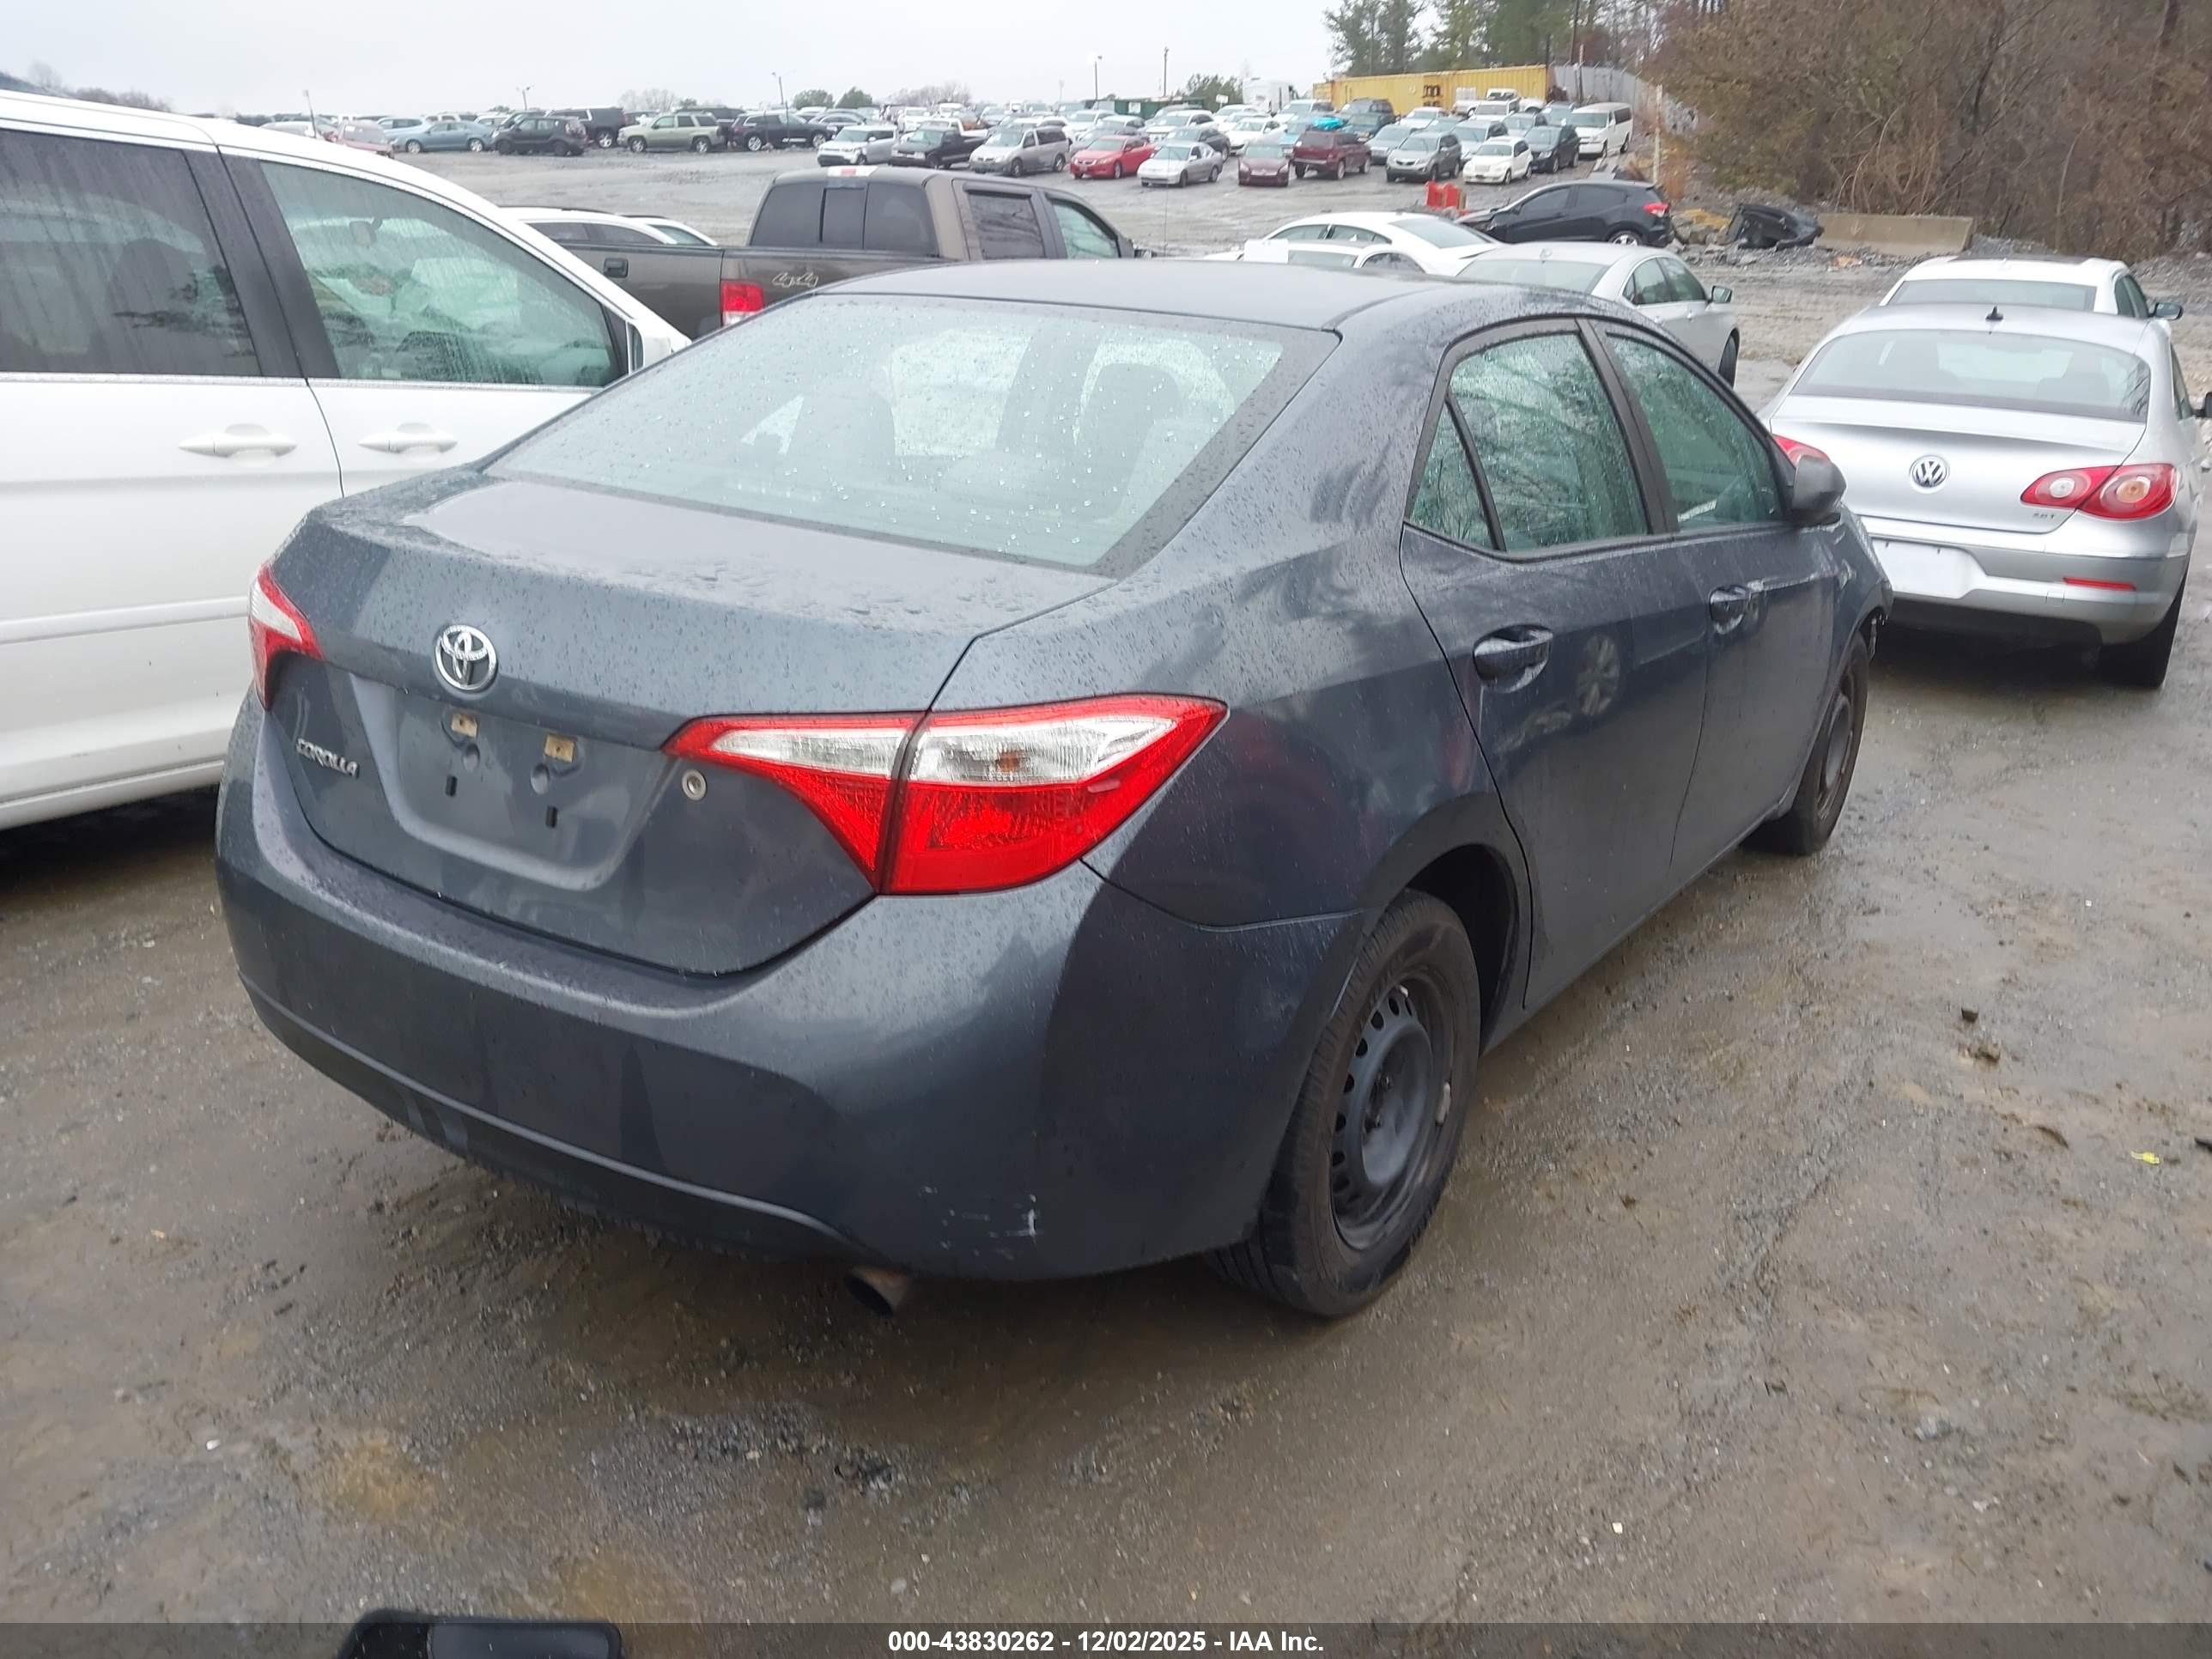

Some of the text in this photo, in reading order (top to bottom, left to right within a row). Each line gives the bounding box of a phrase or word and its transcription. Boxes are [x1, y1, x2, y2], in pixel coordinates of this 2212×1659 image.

[771, 271, 819, 288] 4x4
[1912, 459, 1947, 488] VW
[295, 738, 358, 776] COROLLA
